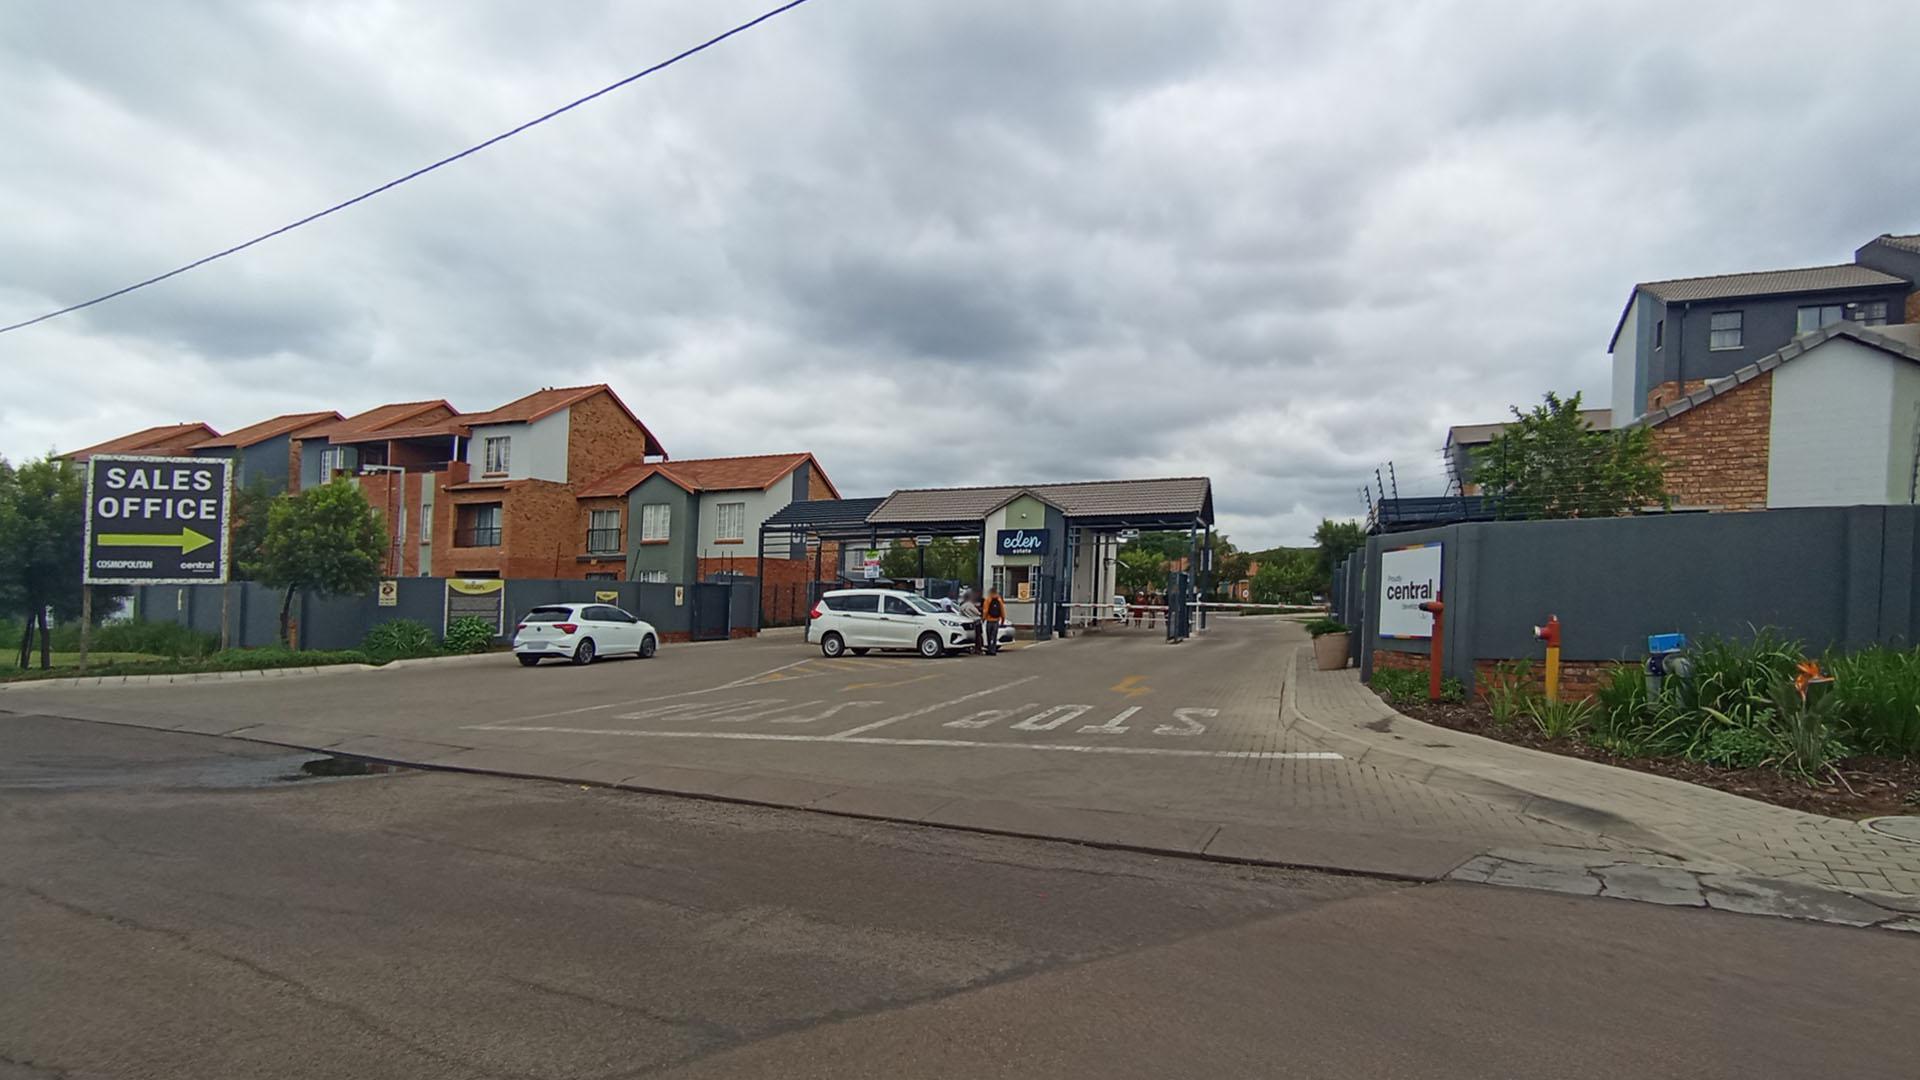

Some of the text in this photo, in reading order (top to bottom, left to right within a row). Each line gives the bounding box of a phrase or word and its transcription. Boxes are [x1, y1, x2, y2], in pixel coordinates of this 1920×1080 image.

[106, 468, 212, 491] SALES
[98, 497, 217, 519] OFFICE
[1003, 530, 1042, 548] eden
[96, 560, 153, 569] COSMOPOLITAN
[180, 561, 215, 570] central
[1387, 578, 1432, 600] central
[942, 703, 1220, 736] STOP
